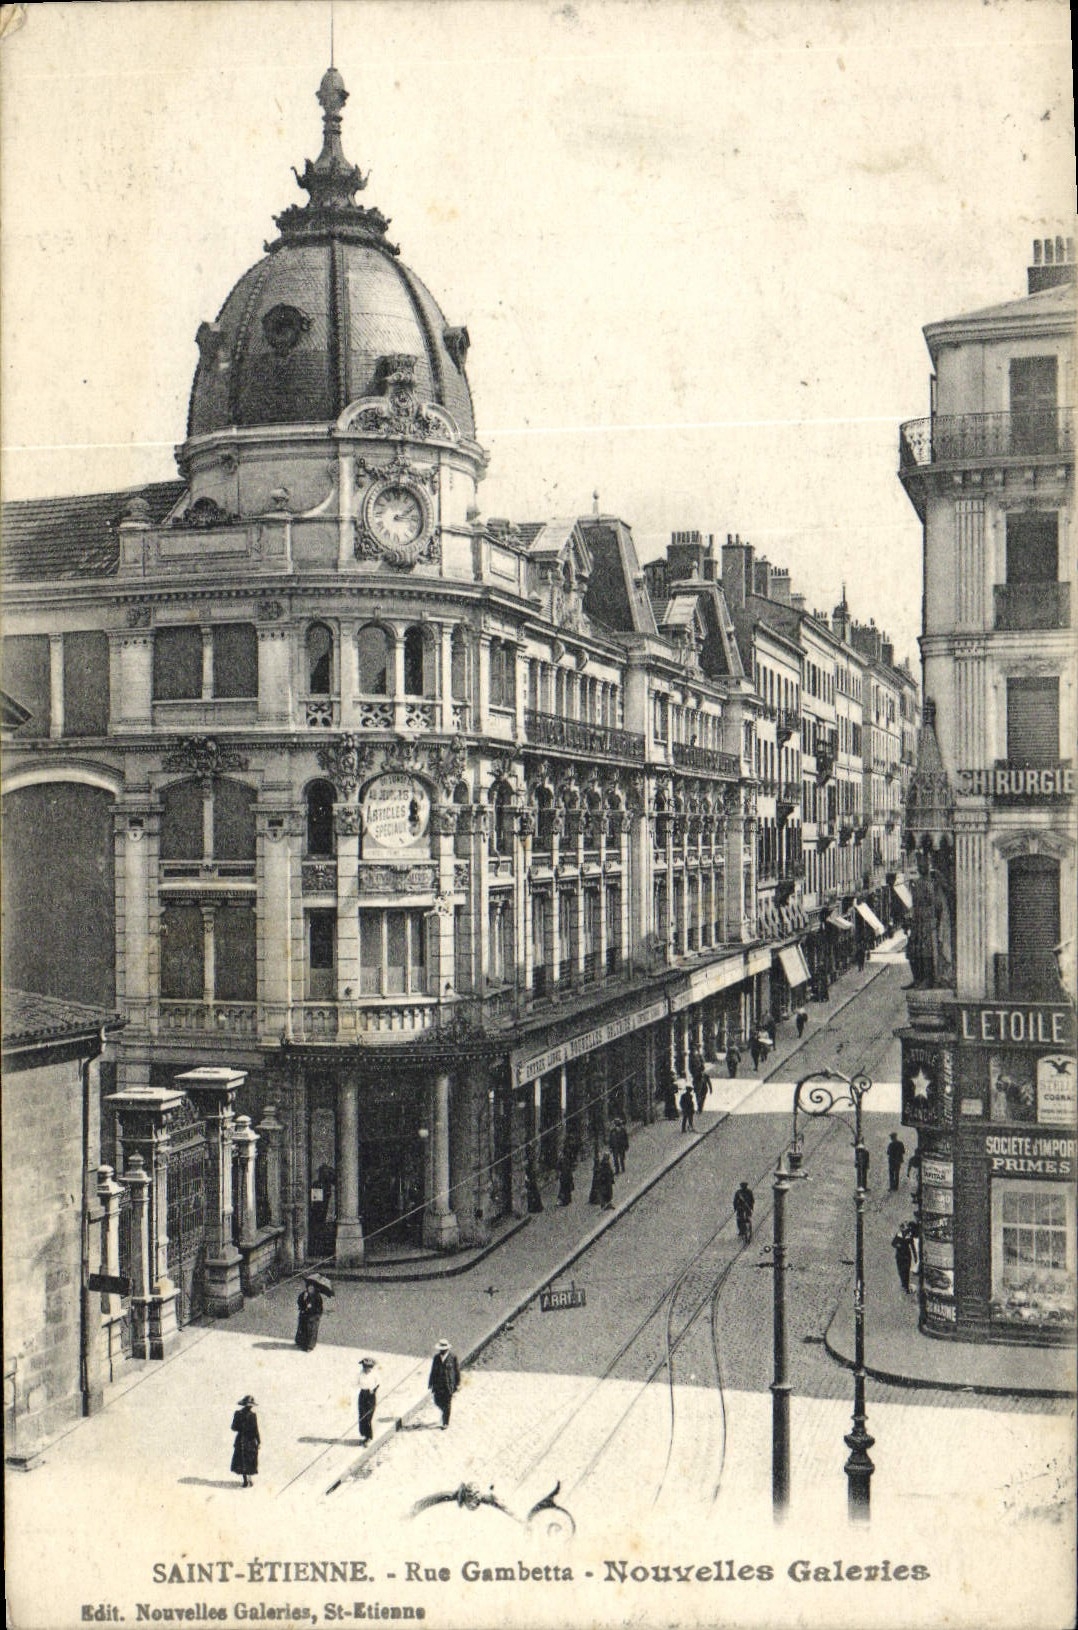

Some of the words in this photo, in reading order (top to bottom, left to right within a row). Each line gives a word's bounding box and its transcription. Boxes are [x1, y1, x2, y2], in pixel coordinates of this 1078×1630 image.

[959, 769, 1076, 797] CHIRURGIE
[366, 804, 406, 824] ARTICLES
[992, 1157, 1072, 1174] PRIMES
